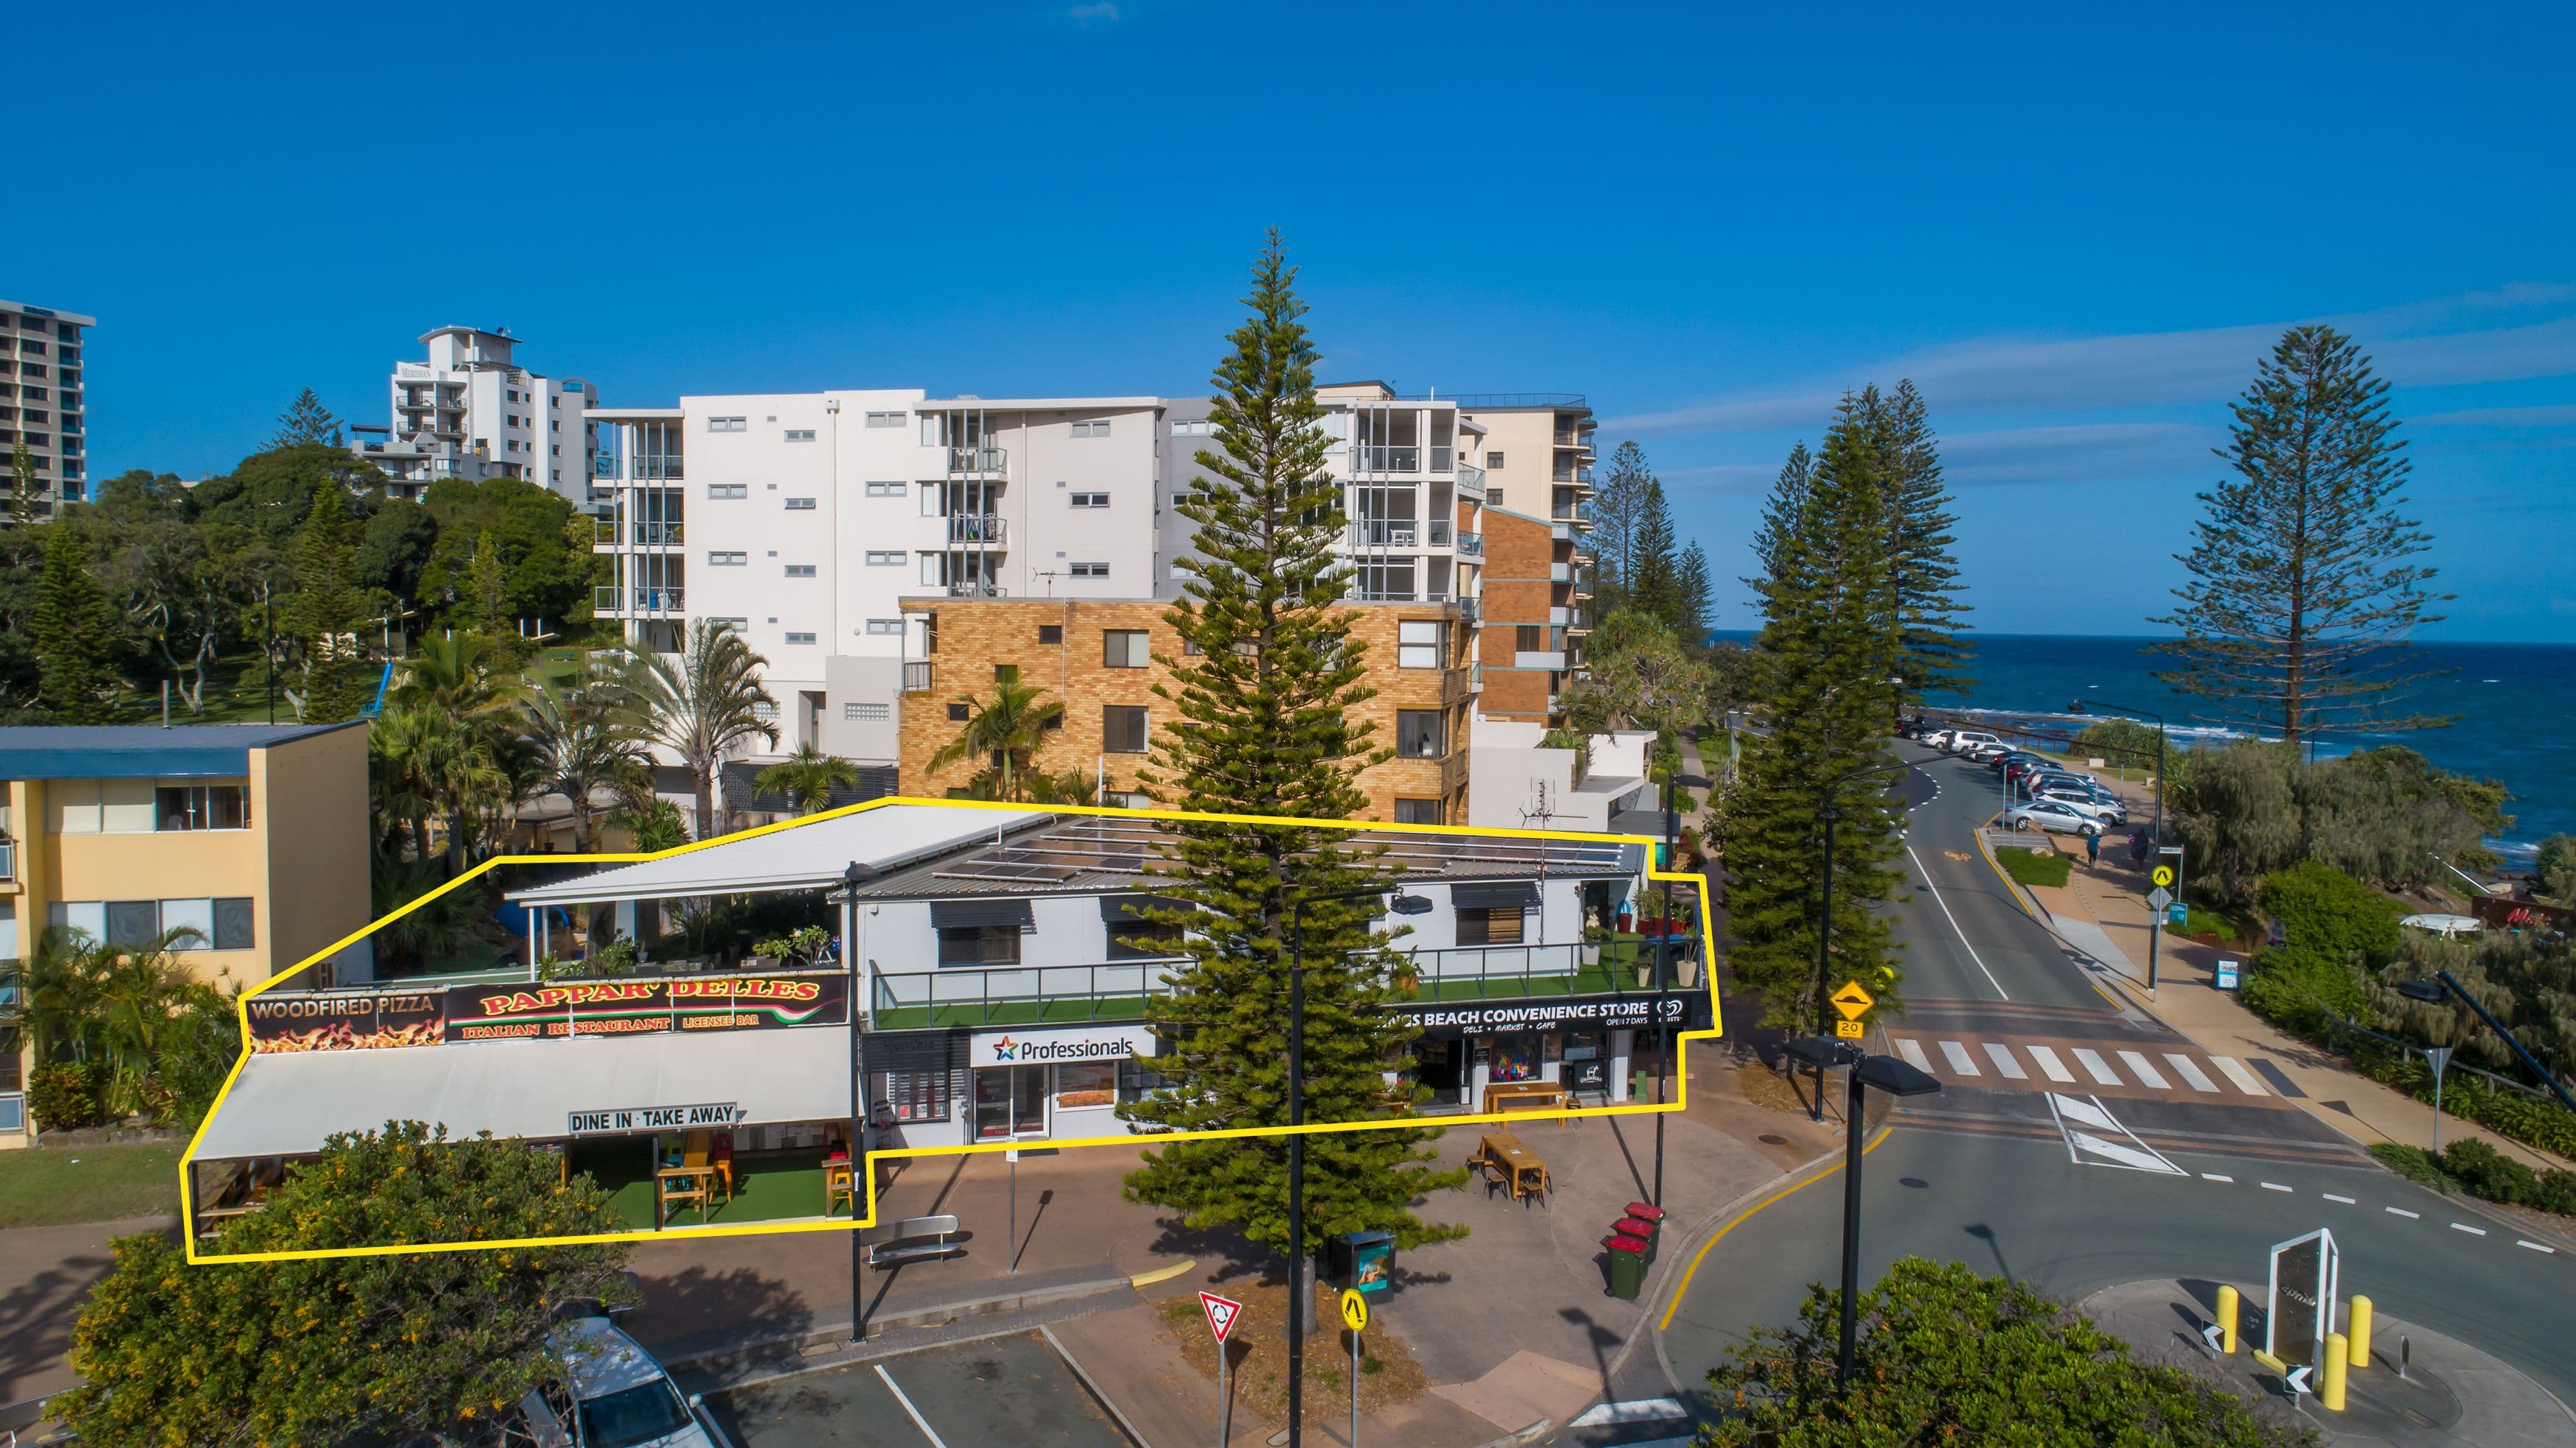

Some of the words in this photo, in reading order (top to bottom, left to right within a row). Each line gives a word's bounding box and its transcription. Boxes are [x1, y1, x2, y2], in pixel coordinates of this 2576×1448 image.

[666, 979, 820, 1000] DELLES
[252, 998, 372, 1019] WOODFIRED
[379, 996, 434, 1013] PIZZA
[1424, 1011, 1479, 1025] BEACH
[1483, 1005, 1596, 1023] CONVENIENCE
[1599, 1002, 1649, 1017] STORE
[462, 1025, 539, 1039] ITALIAN
[548, 1017, 670, 1035] RESTAURANT
[682, 1016, 735, 1028] LICENSED
[737, 1014, 759, 1025] BAR
[1463, 1025, 1483, 1034] DELI
[1495, 1023, 1524, 1032] MARKET
[1536, 1021, 1556, 1030] CAFE
[1607, 1018, 1624, 1026] OPEN
[1631, 1017, 1648, 1025] DAYS
[1841, 1023, 1858, 1032] 20
[1022, 1038, 1133, 1060] Professionals
[572, 1114, 609, 1131] DINE
[616, 1112, 631, 1128] IN
[643, 1109, 683, 1126] TAKE
[690, 1106, 734, 1122] AWAY
